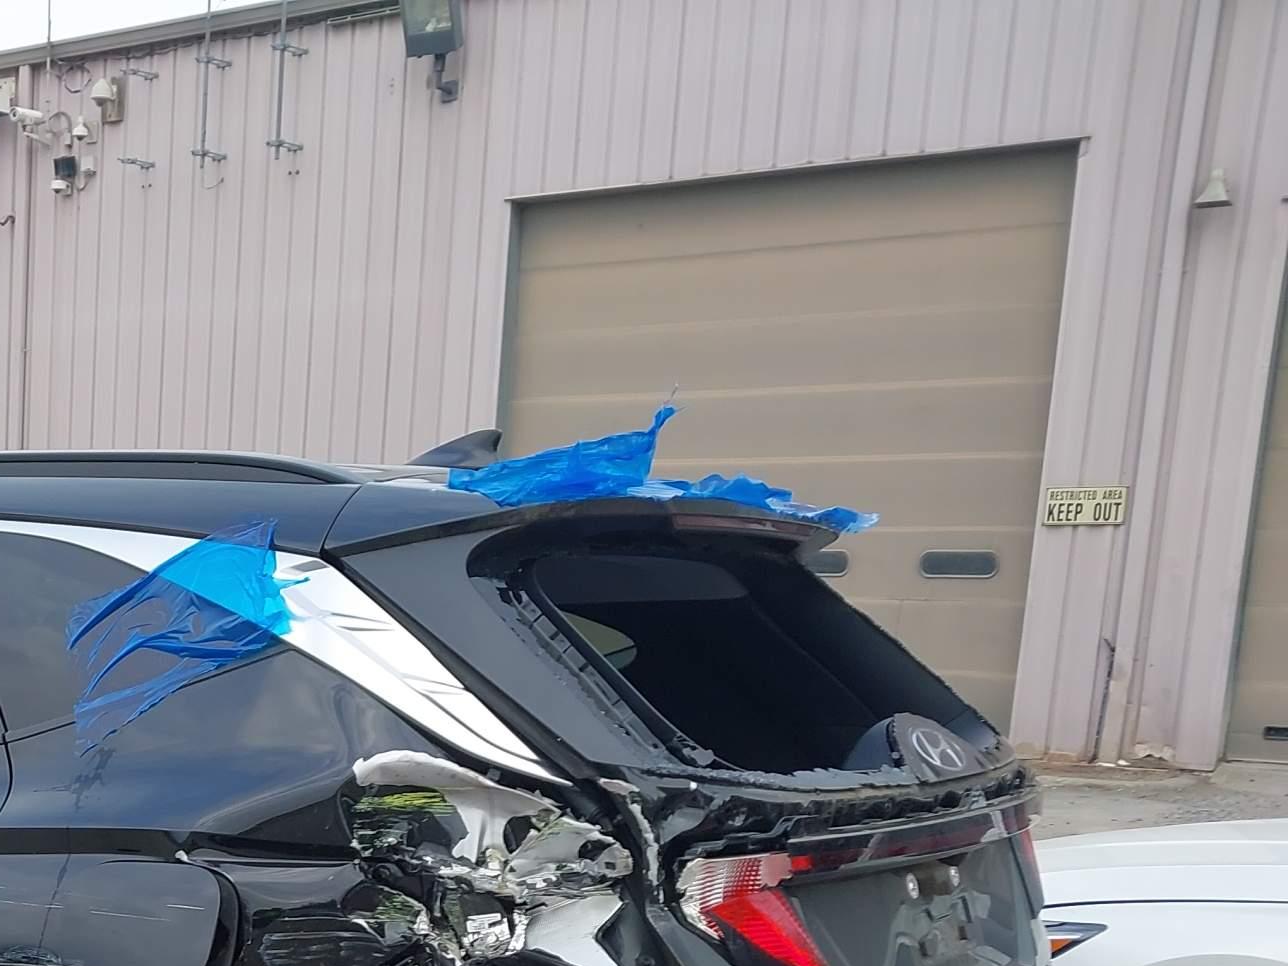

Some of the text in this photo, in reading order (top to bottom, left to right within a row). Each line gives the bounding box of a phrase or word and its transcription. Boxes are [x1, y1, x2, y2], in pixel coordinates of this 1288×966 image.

[1049, 489, 1123, 501] RESTRICTED AREA
[1047, 502, 1122, 522] KEEP OUT
